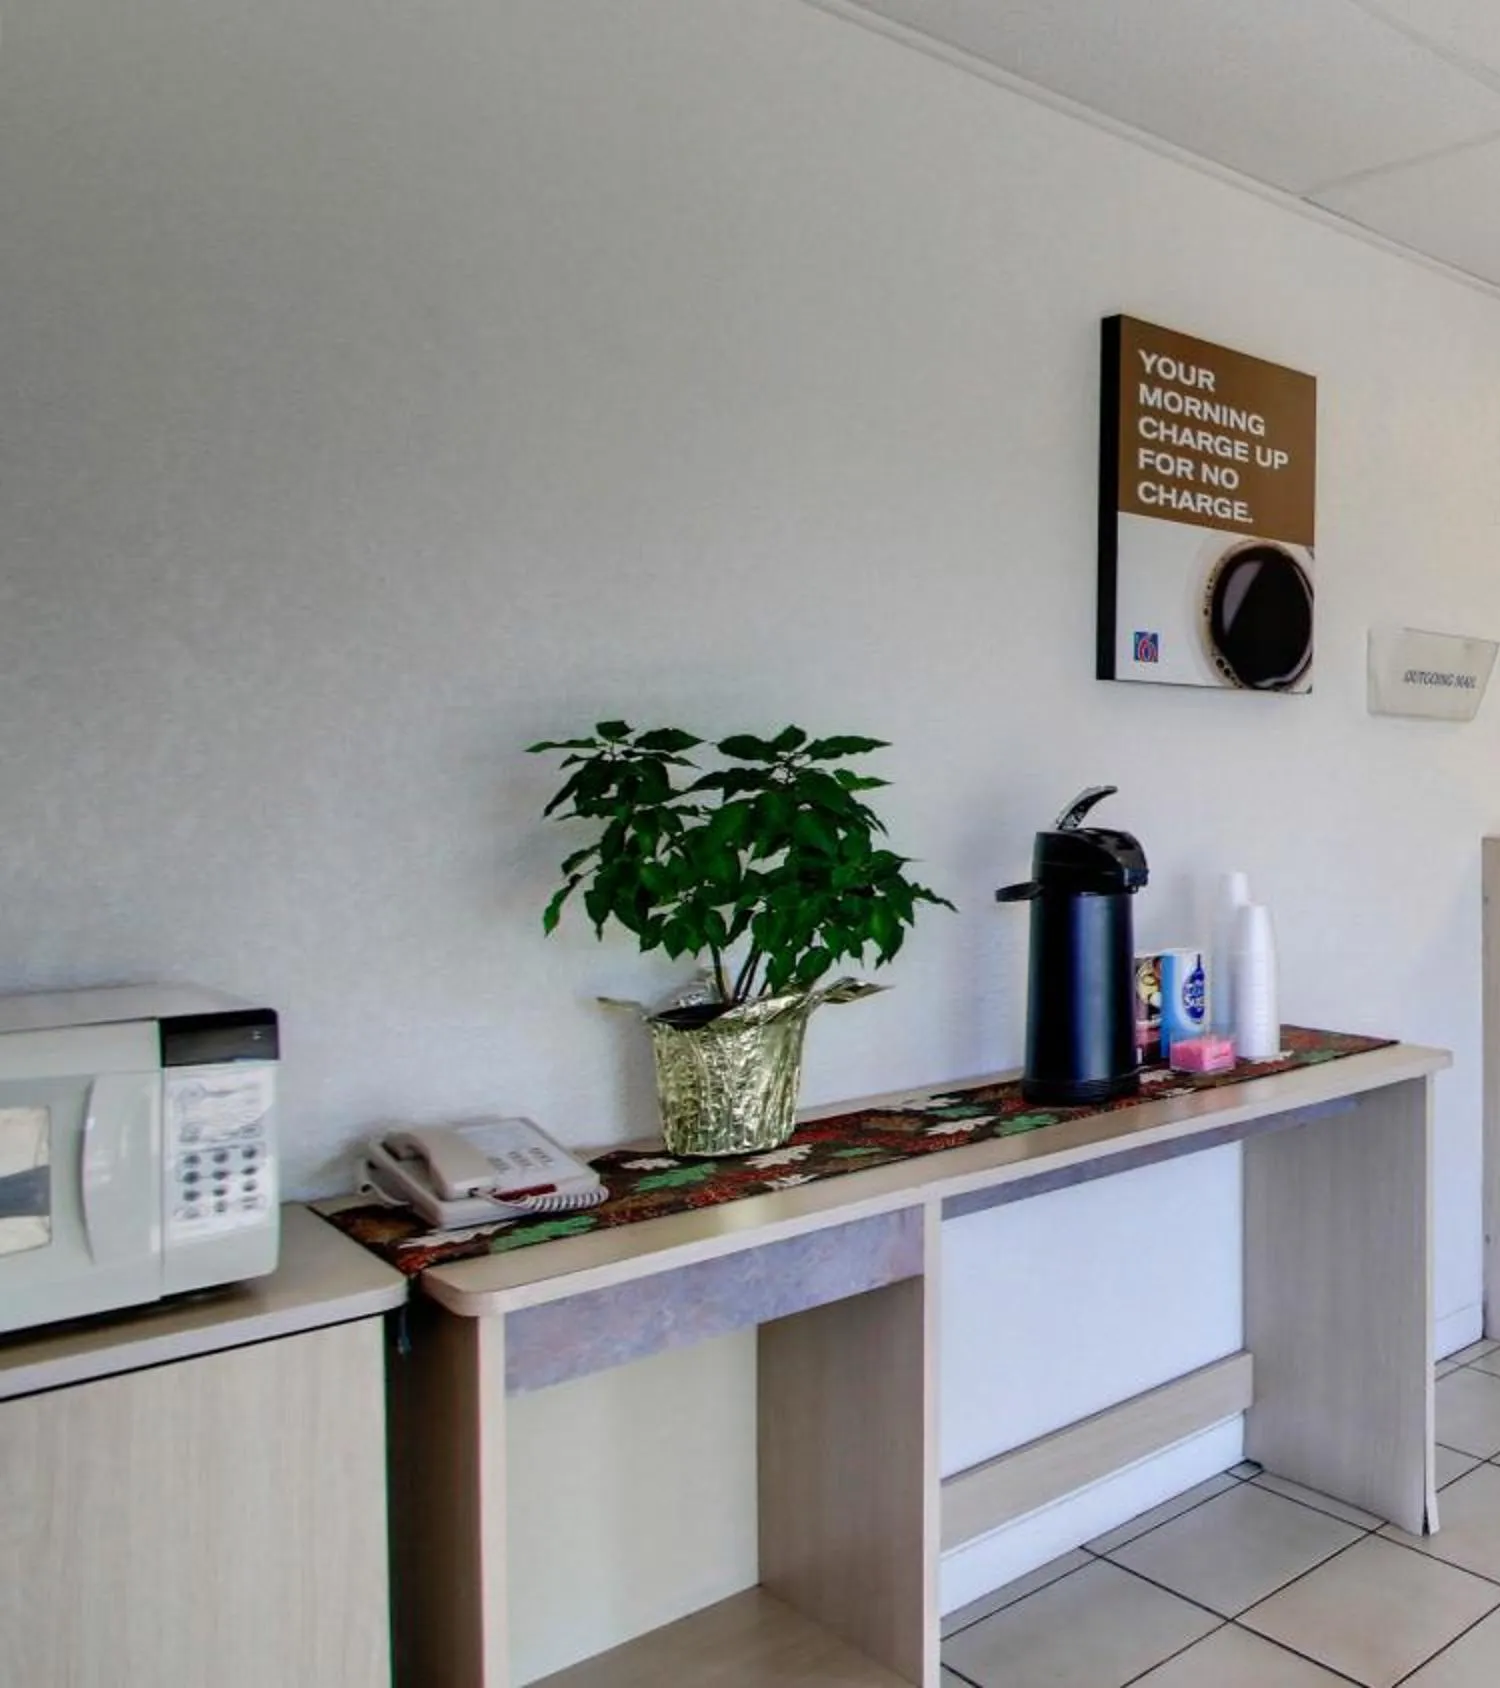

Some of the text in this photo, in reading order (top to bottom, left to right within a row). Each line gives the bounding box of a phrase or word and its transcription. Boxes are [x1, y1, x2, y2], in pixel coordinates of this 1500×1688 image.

[1138, 348, 1216, 393] YOUR
[1138, 382, 1266, 437] MORNING
[1138, 415, 1289, 471] CHARGE UP
[1138, 447, 1240, 491] FOR NO
[1137, 480, 1254, 525] CHARGE.
